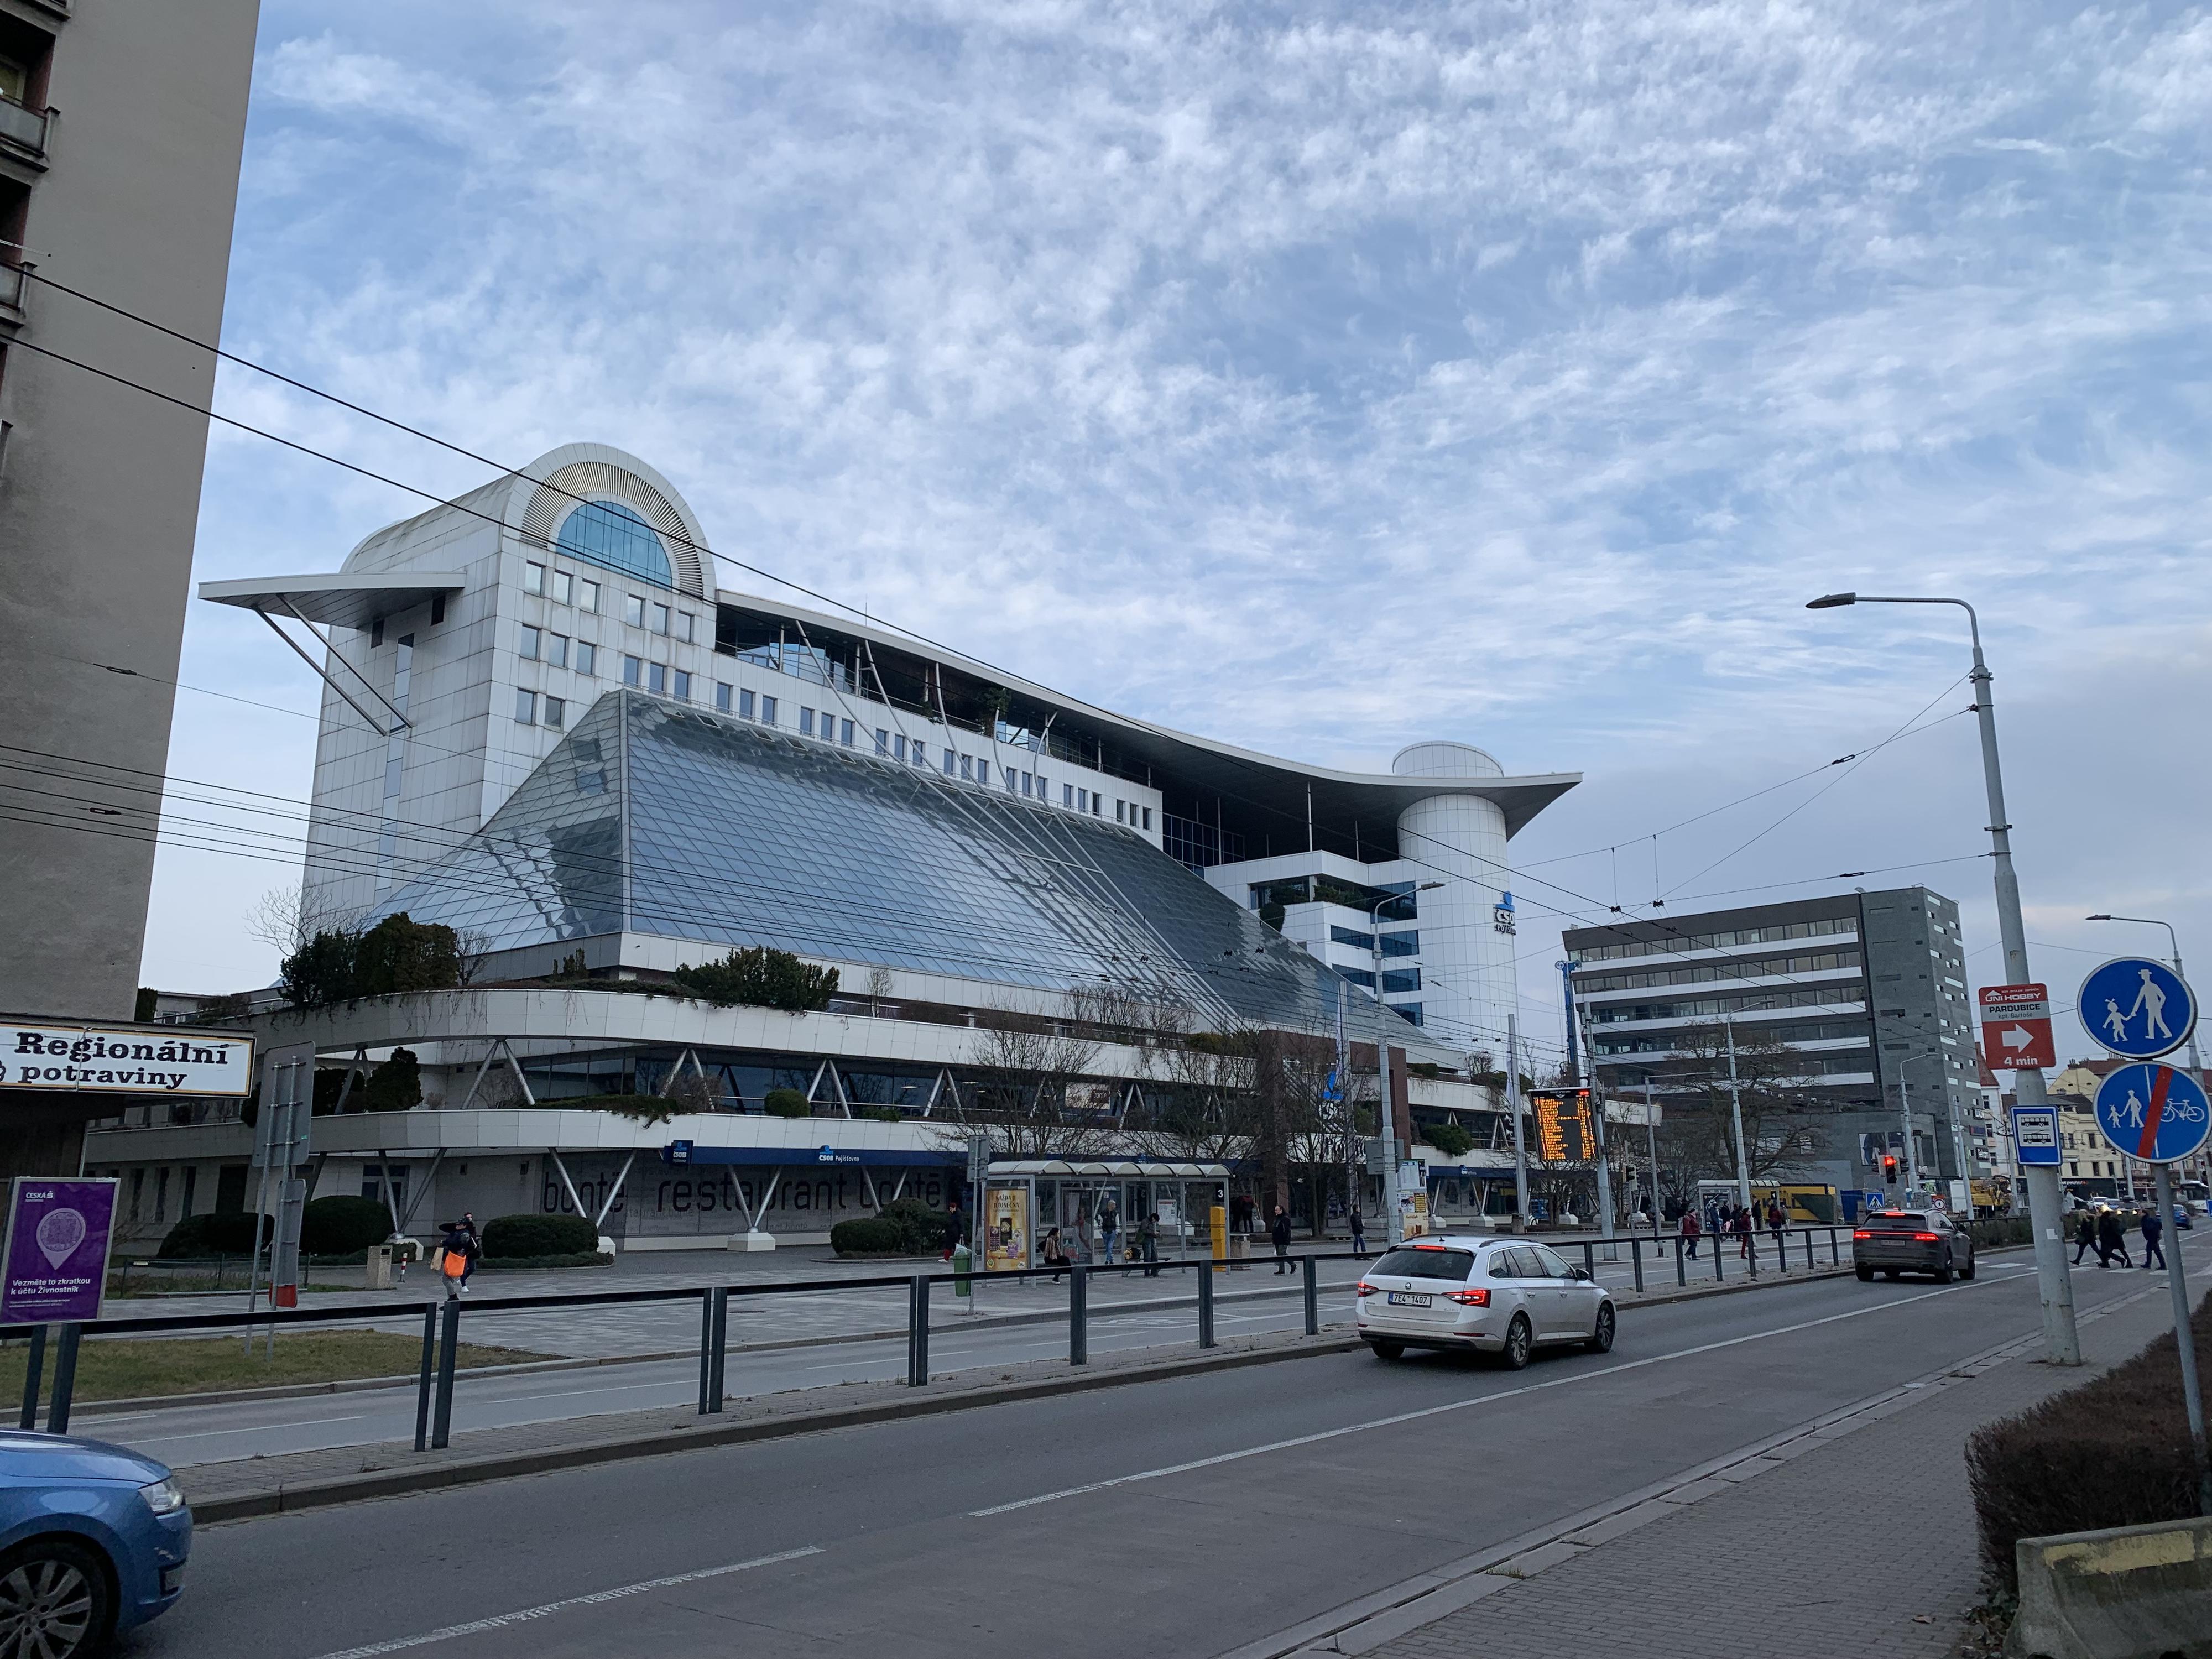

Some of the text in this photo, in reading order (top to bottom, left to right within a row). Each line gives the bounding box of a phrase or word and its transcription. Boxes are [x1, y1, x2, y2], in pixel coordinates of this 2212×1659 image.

[1989, 1004, 2041, 1013] PARDUBICE
[14, 1032, 228, 1065] Regionální
[2004, 1056, 2038, 1065] 4 min
[18, 1066, 187, 1089] potraviny
[657, 1172, 847, 1213] restaurant
[1218, 1190, 1223, 1198] 3
[1394, 1294, 1427, 1305] 7E4 1407
